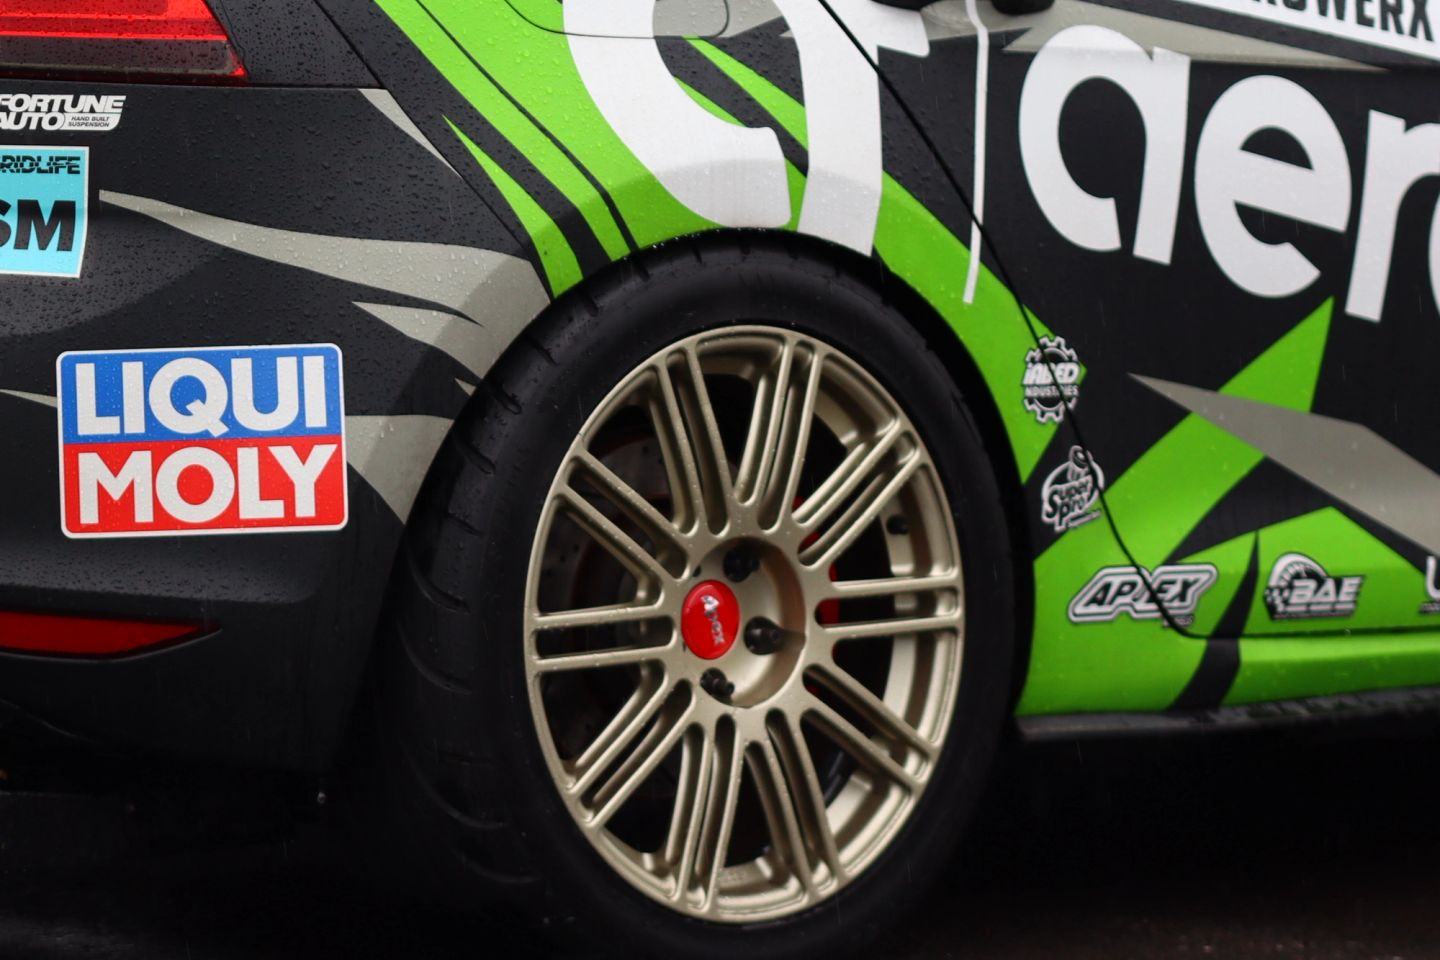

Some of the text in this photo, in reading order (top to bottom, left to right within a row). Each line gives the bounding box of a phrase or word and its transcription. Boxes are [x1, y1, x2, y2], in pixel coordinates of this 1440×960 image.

[1018, 24, 1440, 323] aer
[75, 355, 327, 438] LIQUI
[78, 444, 338, 525] MOLY
[1288, 576, 1364, 603] BAE
